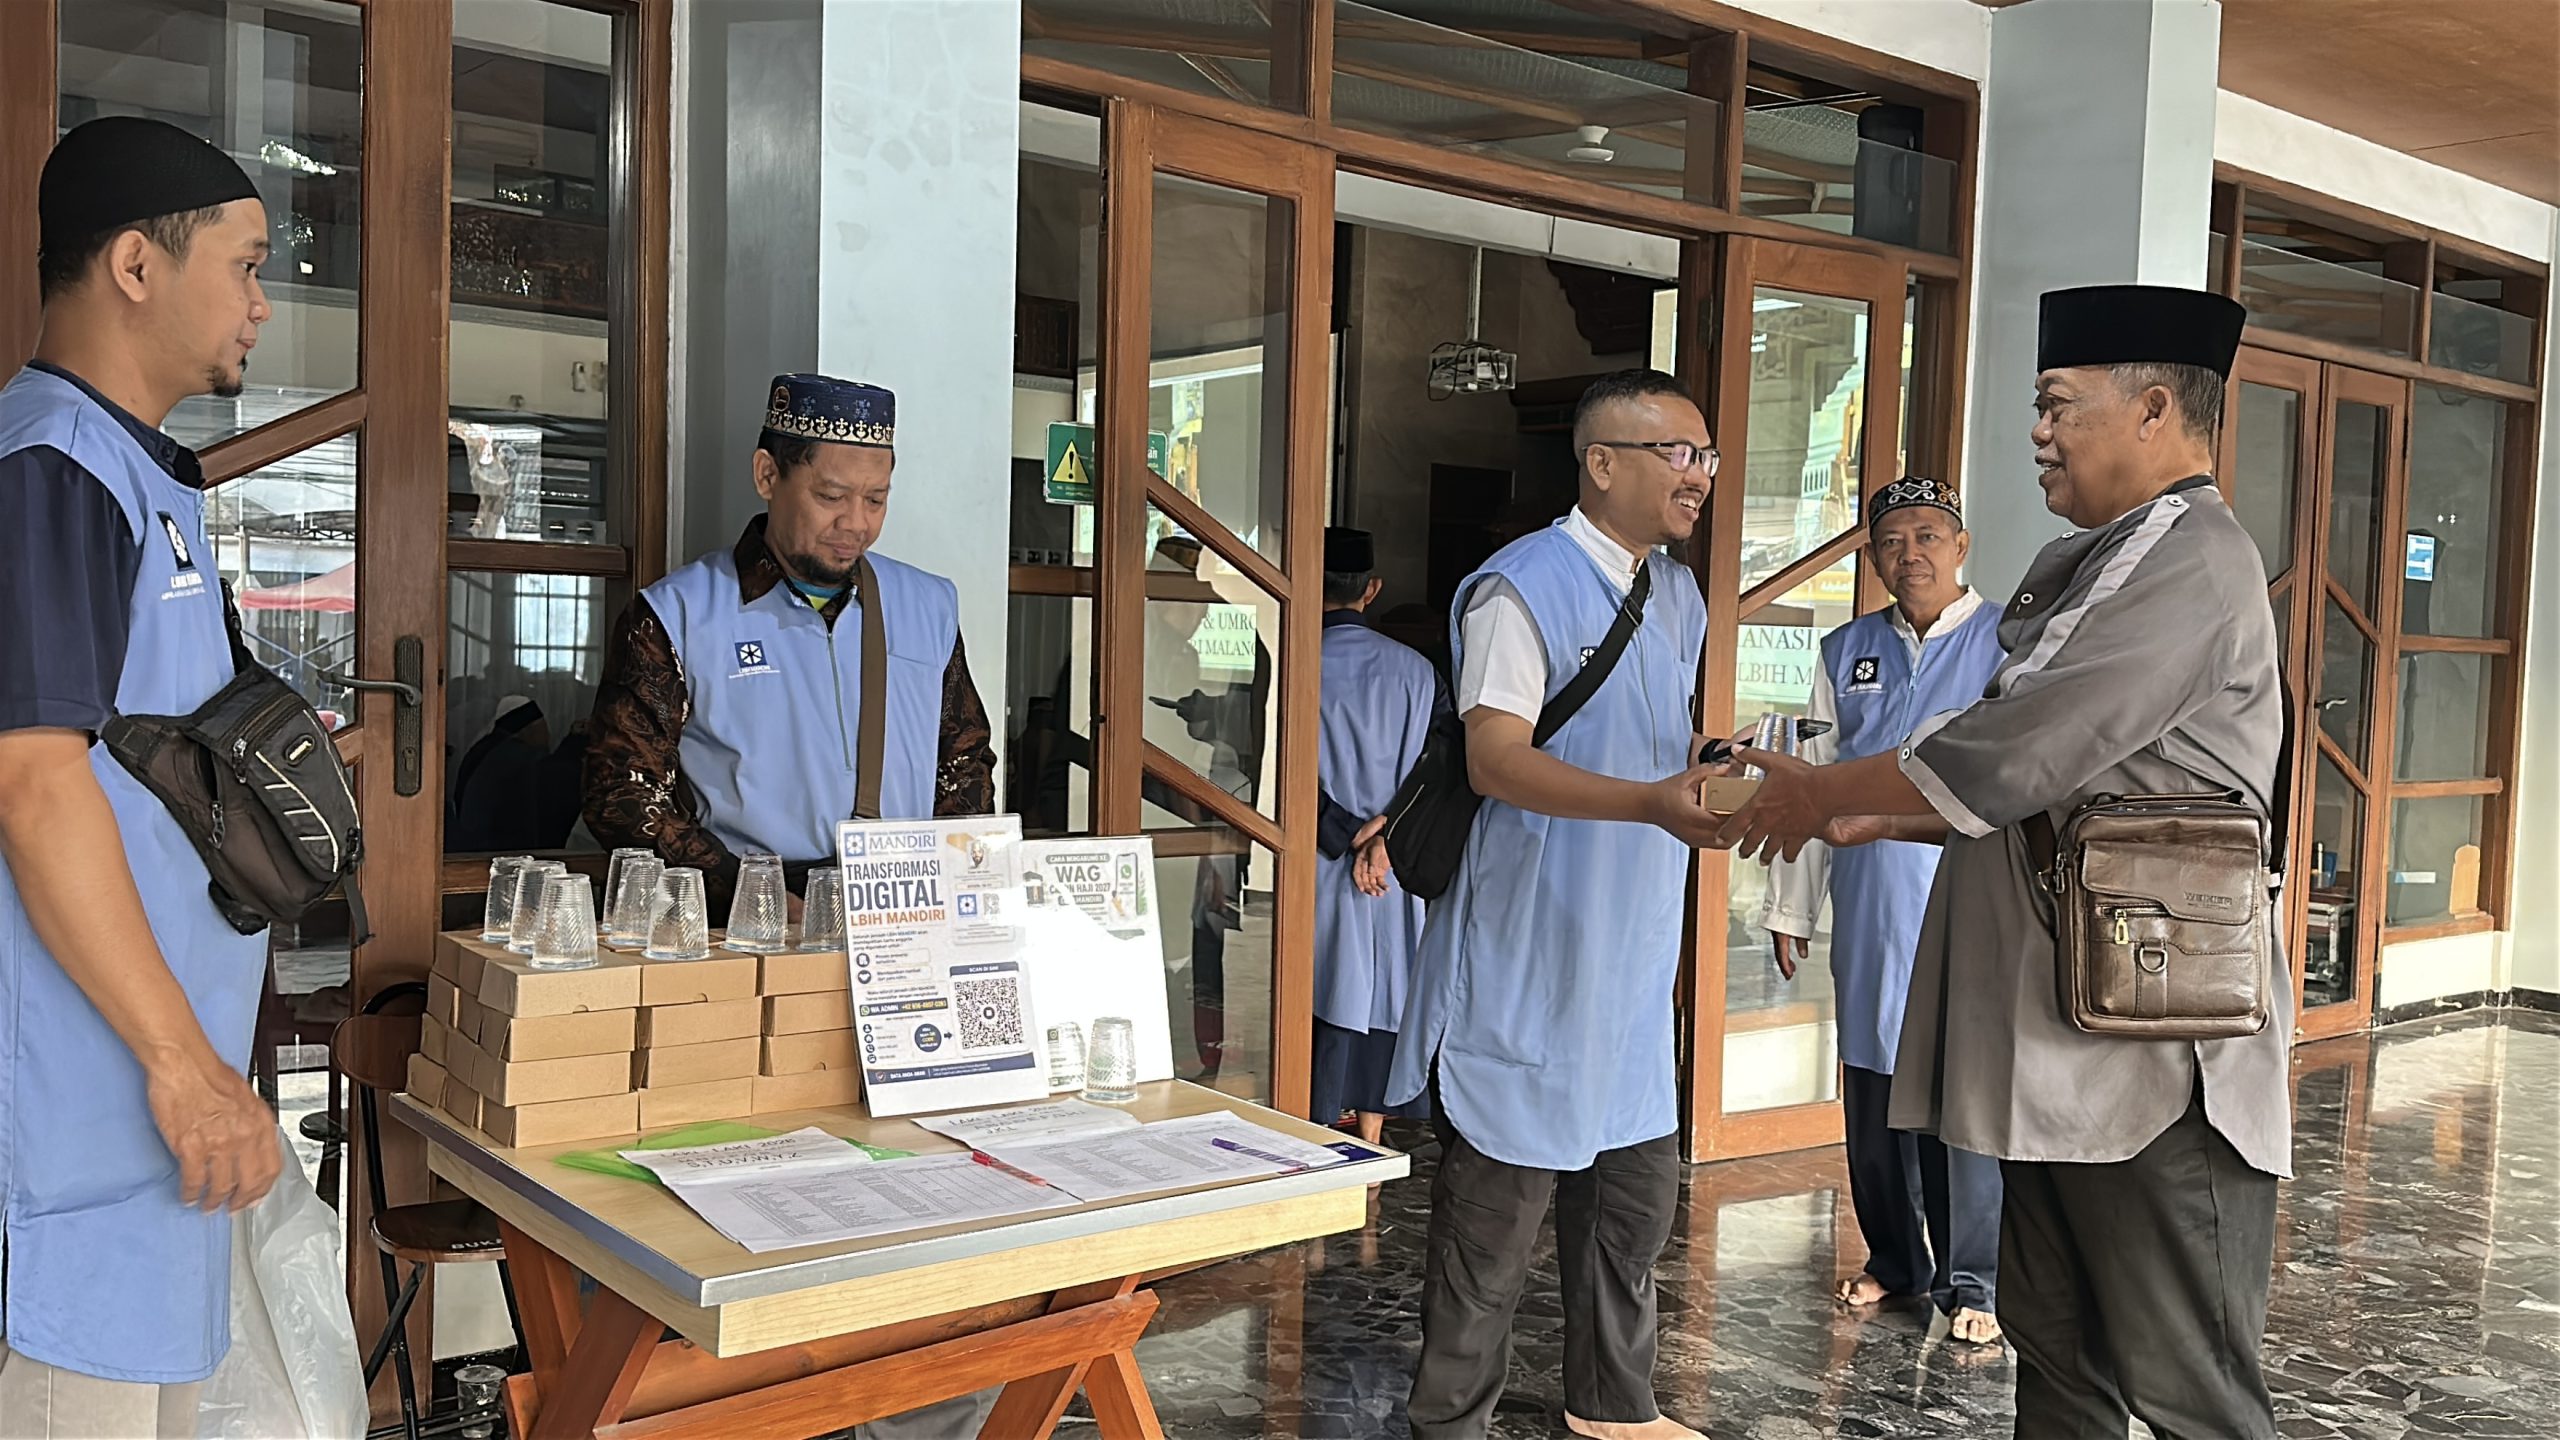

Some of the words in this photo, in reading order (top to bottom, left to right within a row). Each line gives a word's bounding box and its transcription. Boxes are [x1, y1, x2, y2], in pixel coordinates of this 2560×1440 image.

[1738, 662, 1787, 684] LBIH
[869, 834, 936, 850] MANDIRI
[845, 859, 941, 881] TRANSFORMASI
[1055, 864, 1101, 883] WAG
[848, 879, 944, 911] DIGITAL
[1076, 883, 1093, 893] HAJI
[850, 912, 882, 926] LBIH
[886, 909, 945, 925] MANDIRI
[871, 1005, 880, 1013] WA
